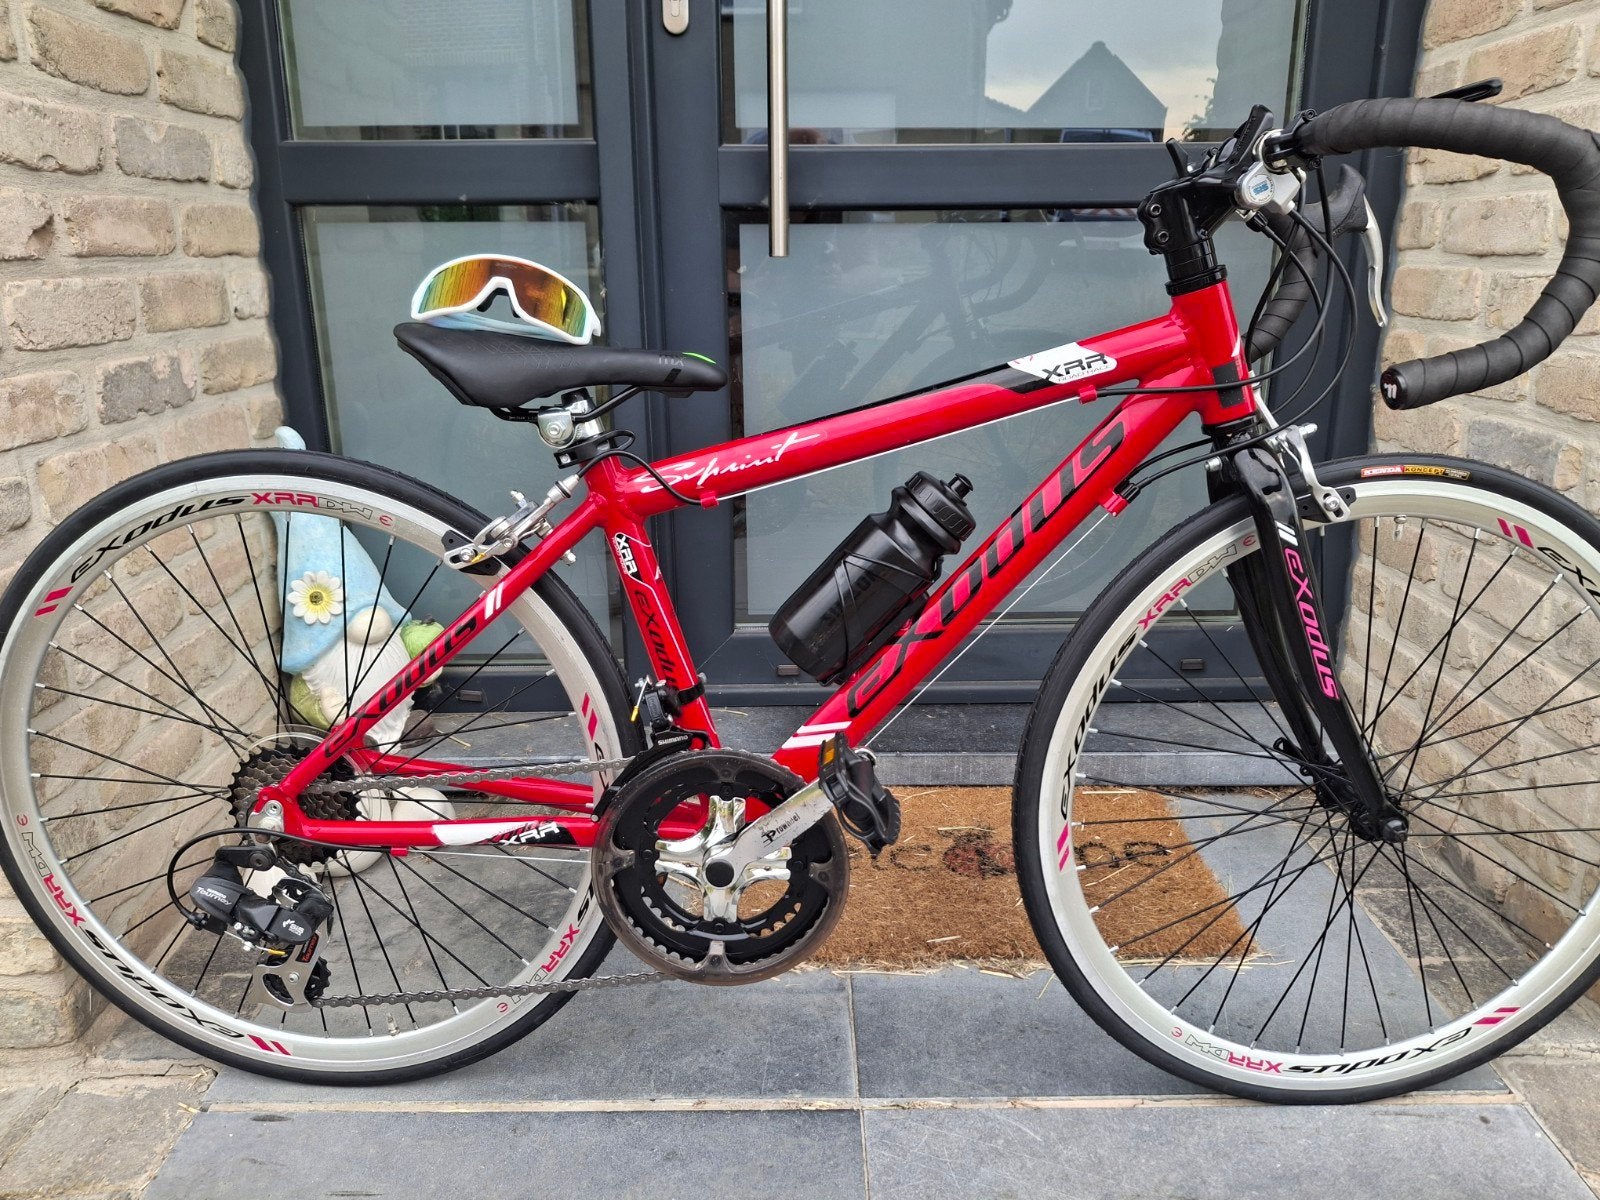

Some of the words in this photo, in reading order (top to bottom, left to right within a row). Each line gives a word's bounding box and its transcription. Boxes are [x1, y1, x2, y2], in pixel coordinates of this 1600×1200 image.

[1042, 353, 1107, 380] XRR
[616, 535, 638, 574] XRR
[657, 735, 689, 746] SHIMANO
[500, 821, 561, 846] XRR
[195, 886, 233, 906] Tourney
